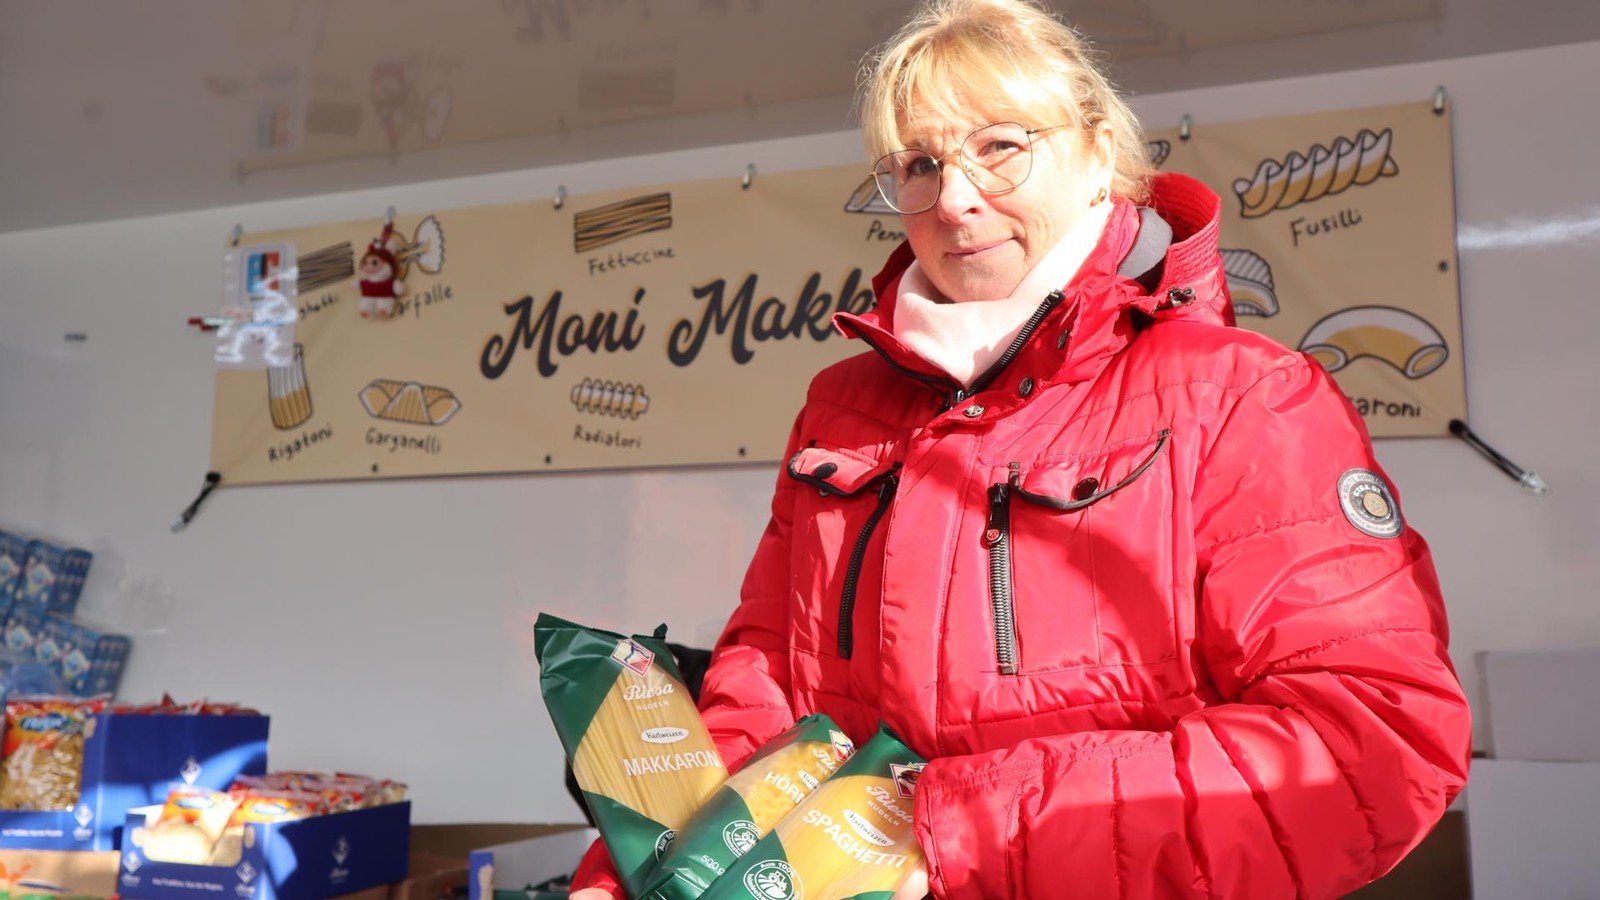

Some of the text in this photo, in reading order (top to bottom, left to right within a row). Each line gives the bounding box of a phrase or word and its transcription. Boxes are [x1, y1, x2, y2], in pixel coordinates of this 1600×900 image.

[866, 219, 908, 242] Penn
[1290, 208, 1363, 246] Fusilli
[588, 246, 676, 275] Fettuccine
[480, 268, 874, 380] Moni Makk
[1350, 396, 1421, 418] aroni
[268, 424, 333, 463] Rigatoni
[365, 427, 442, 454] Garganelli
[573, 423, 642, 449] Radiatori
[623, 683, 675, 701] Riesa
[636, 700, 670, 711] NUDELN
[645, 730, 685, 740] Hartweizen
[867, 799, 901, 827] NUDELN
[802, 808, 907, 869] SPAGHETTI
[848, 812, 888, 846] Hartweizen
[700, 854, 720, 870] 500
